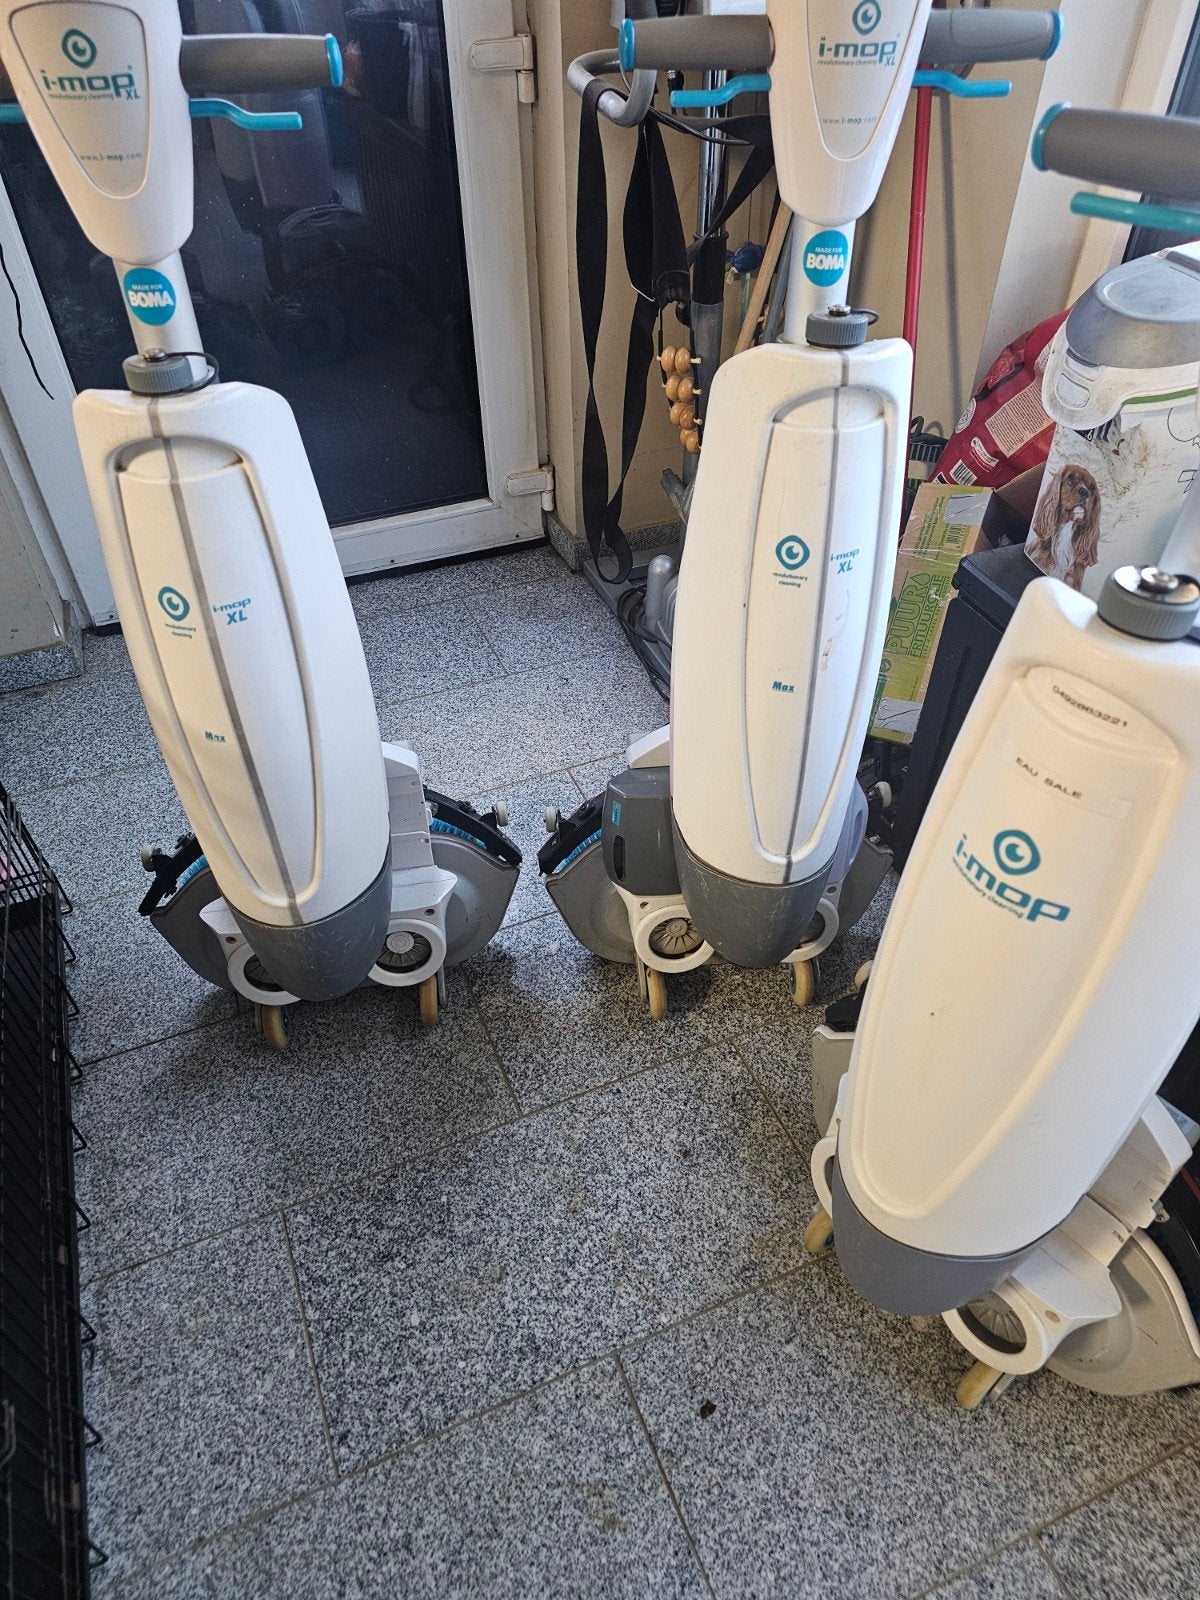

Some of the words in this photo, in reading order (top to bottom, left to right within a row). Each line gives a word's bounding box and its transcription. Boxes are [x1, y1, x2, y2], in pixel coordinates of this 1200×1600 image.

[818, 37, 897, 64] i-mop
[884, 56, 896, 67] XL
[40, 69, 136, 98] i-mop
[126, 88, 141, 100] XL
[806, 252, 845, 270] BOMA
[127, 290, 174, 307] BOMA
[830, 548, 860, 562] i-mop
[837, 560, 853, 574] XL
[772, 572, 808, 581] revolutionary
[778, 580, 801, 588] cleaning
[212, 597, 252, 613] i-mop
[226, 610, 248, 625] XL
[886, 584, 927, 656] PUUR
[772, 680, 795, 693] Max
[1015, 757, 1039, 777] EAU
[1044, 778, 1082, 800] SALE
[956, 833, 1070, 922] i-mop
